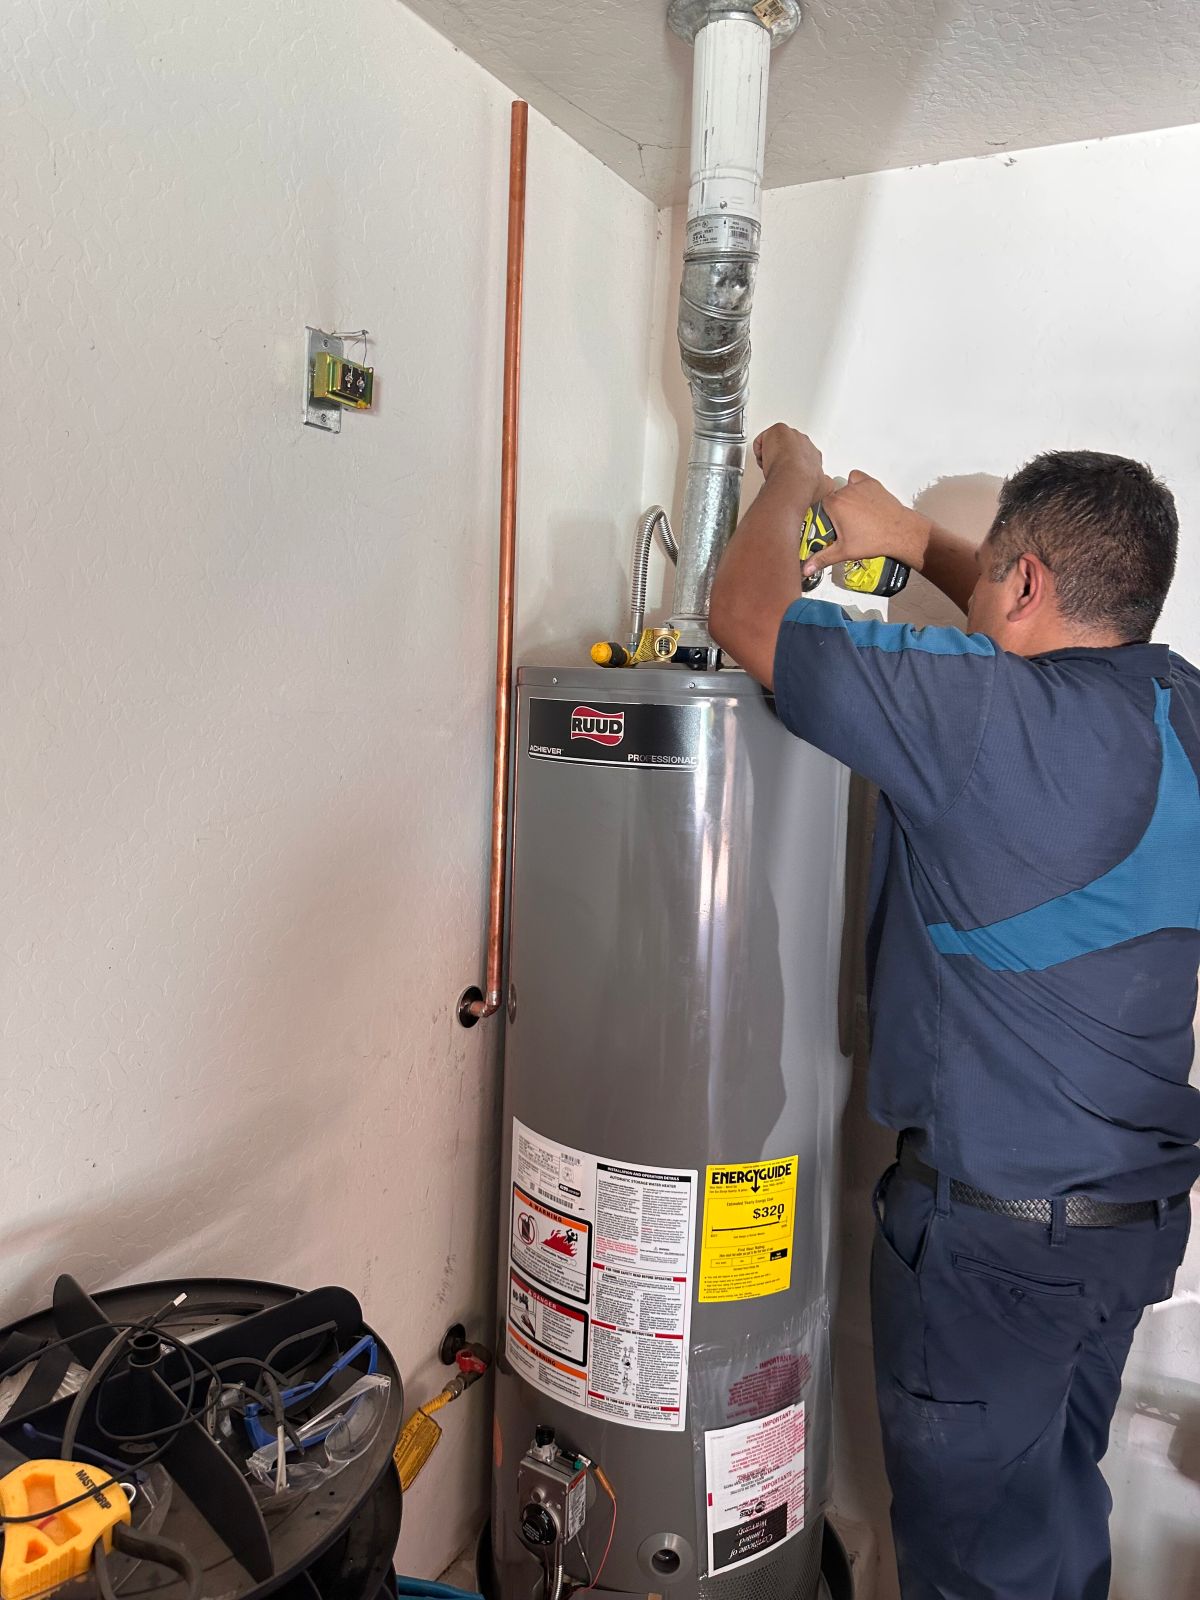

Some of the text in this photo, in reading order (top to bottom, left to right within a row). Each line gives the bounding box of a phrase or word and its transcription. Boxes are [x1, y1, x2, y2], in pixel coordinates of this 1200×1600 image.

[572, 717, 623, 735] RUUD
[529, 744, 562, 755] ACHIEVER
[711, 1163, 792, 1189] ENERGYGUIDE
[534, 1205, 562, 1222] WARNING
[753, 1203, 785, 1220] $320
[533, 1292, 557, 1310] DANGER
[531, 1347, 556, 1367] WARNING
[762, 1410, 791, 1429] IMPORTANT
[761, 1470, 792, 1491] IMPORTANTE
